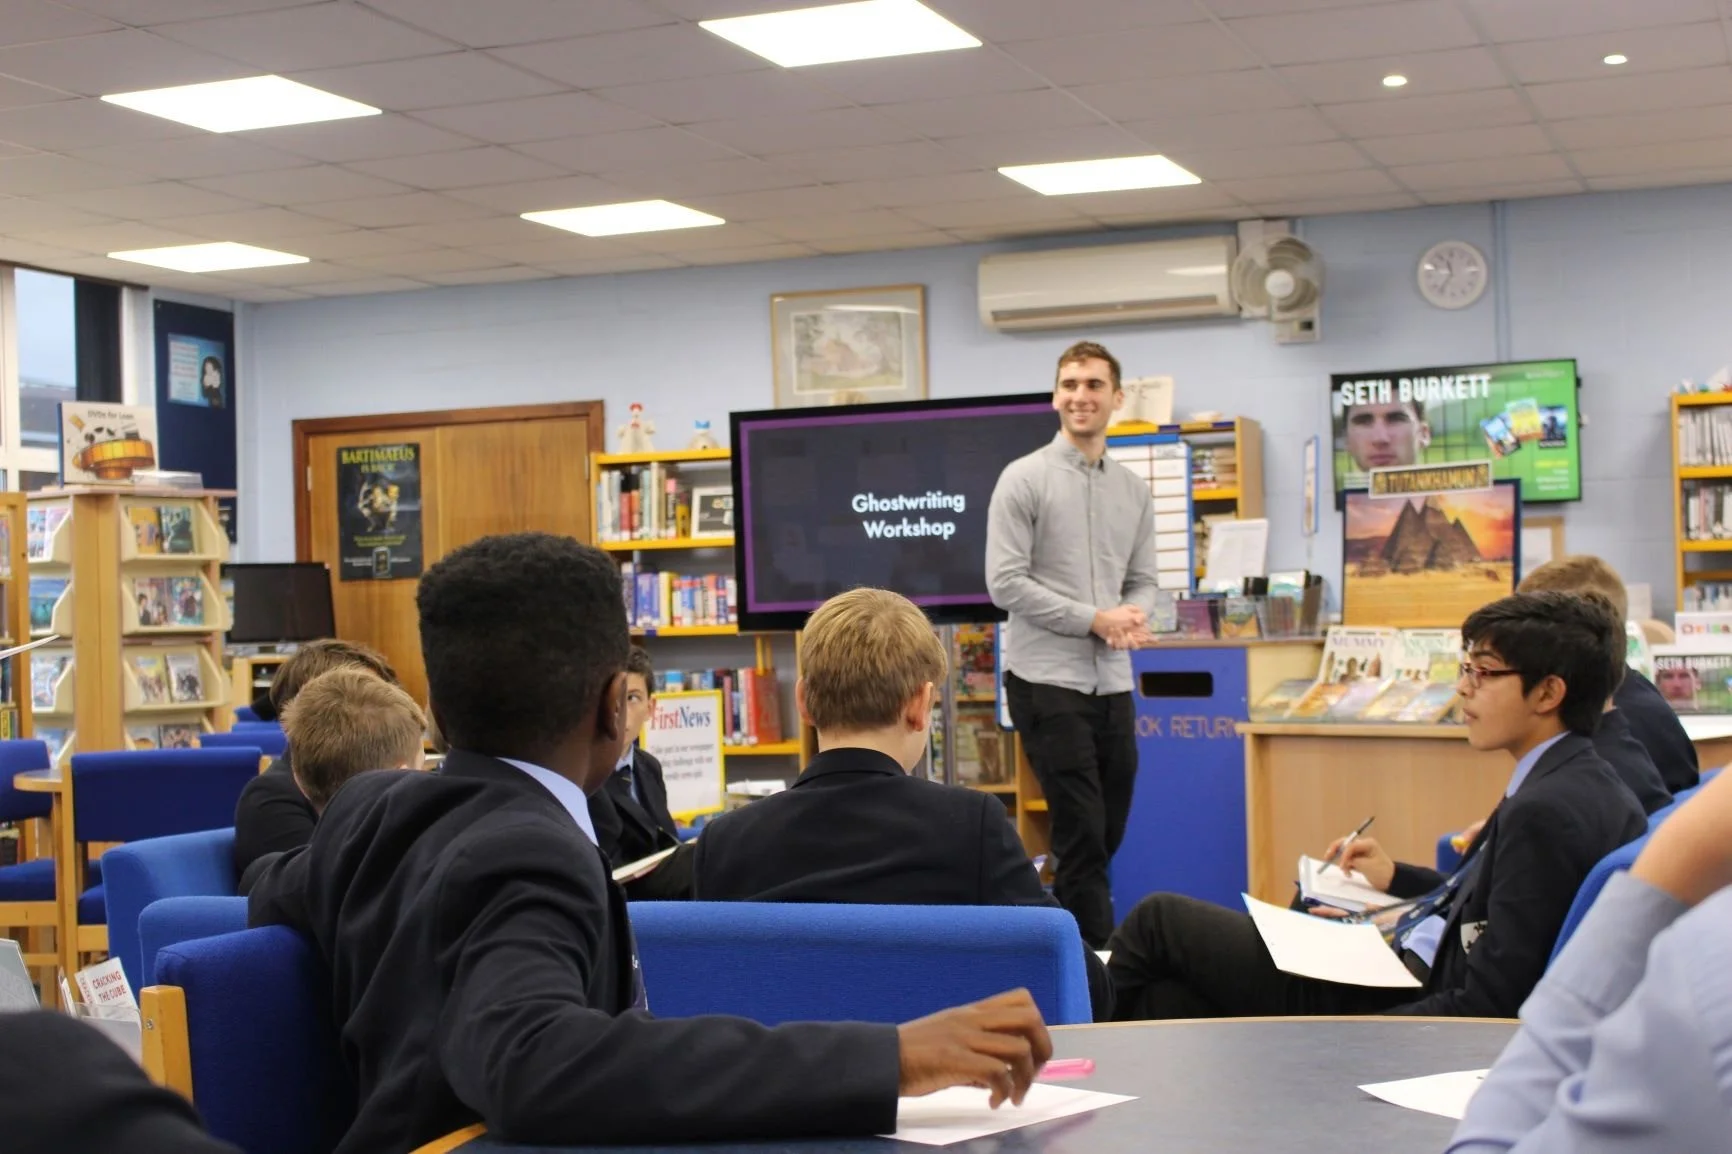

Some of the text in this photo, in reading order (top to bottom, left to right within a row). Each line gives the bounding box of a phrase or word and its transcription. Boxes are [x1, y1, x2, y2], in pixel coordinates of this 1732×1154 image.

[1341, 373, 1491, 406] SETH BURKETT
[342, 447, 415, 465] BARTIMAEUS
[852, 490, 966, 513] Ghostwriting
[862, 516, 956, 540] Workshop
[1655, 655, 1731, 671] SETH BURKETT
[92, 970, 122, 990] CRACKING
[98, 984, 127, 1003] THE CUBE
